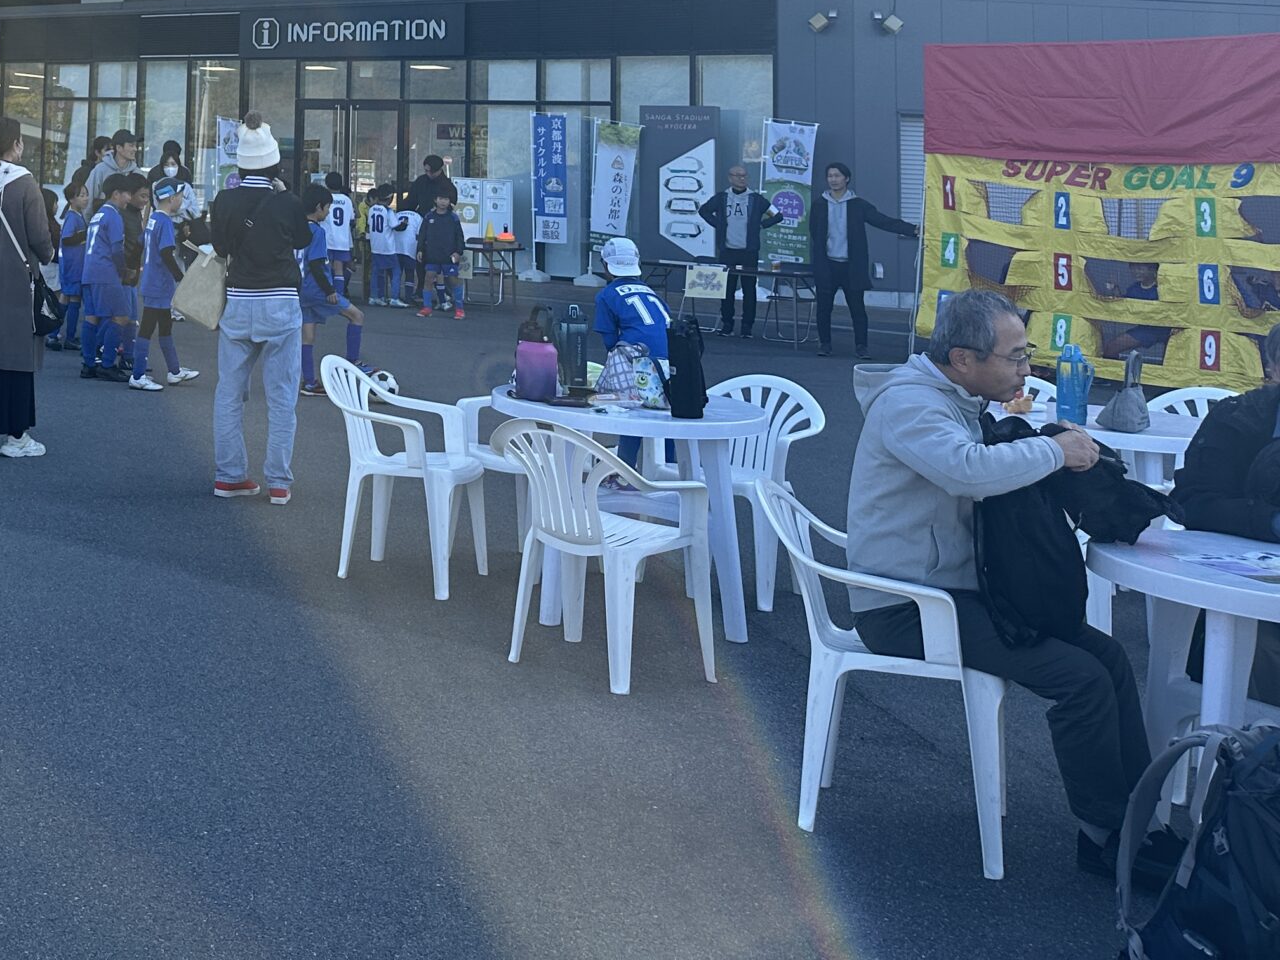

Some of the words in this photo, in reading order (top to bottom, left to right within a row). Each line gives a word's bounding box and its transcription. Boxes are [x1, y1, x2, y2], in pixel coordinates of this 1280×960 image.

[286, 18, 447, 42] INFORMATION
[644, 113, 672, 121] SANGA
[674, 112, 711, 121] STADIUM
[551, 117, 563, 165] 京都丹波
[536, 126, 548, 200] サイクルルート
[1001, 158, 1112, 191] SUPER
[1123, 164, 1217, 191] GOAL
[1230, 161, 1256, 190] 9
[945, 182, 954, 206] 1
[332, 206, 345, 227] 9
[370, 213, 384, 234] 10
[1057, 196, 1067, 225] 2
[1199, 201, 1213, 233] 3
[944, 237, 956, 264] 4
[1057, 257, 1069, 286] 5
[1202, 267, 1215, 300] 6
[1055, 317, 1066, 344] 8
[1203, 334, 1217, 366] 9
